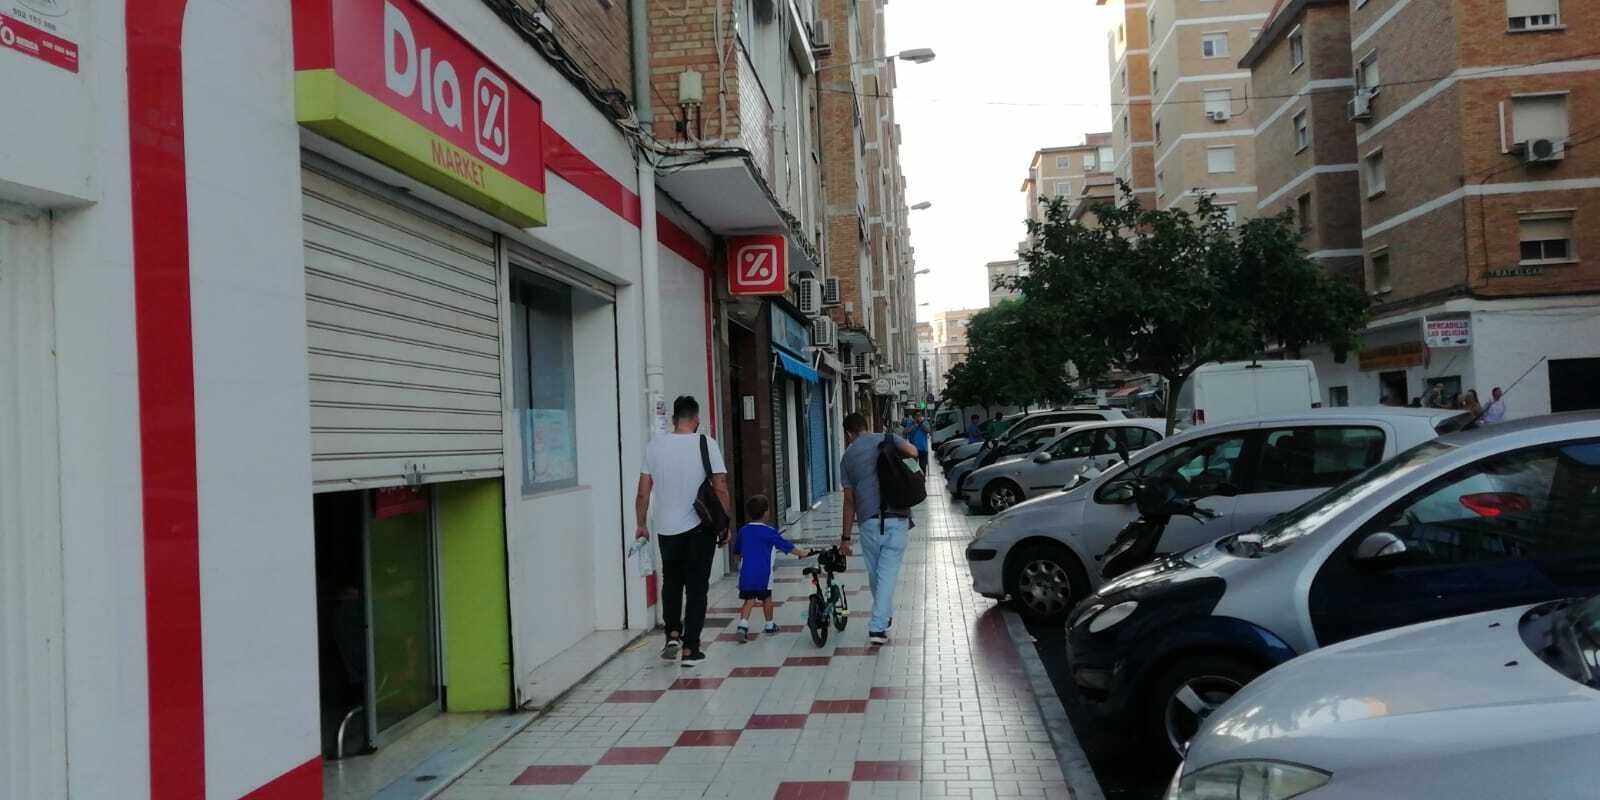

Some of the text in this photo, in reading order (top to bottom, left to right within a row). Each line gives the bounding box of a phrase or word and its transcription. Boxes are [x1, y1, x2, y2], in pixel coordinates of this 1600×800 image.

[431, 141, 487, 189] MARKET
[1427, 320, 1469, 329] MERCADILLO
[1428, 328, 1469, 337] LAS DELICIAS
